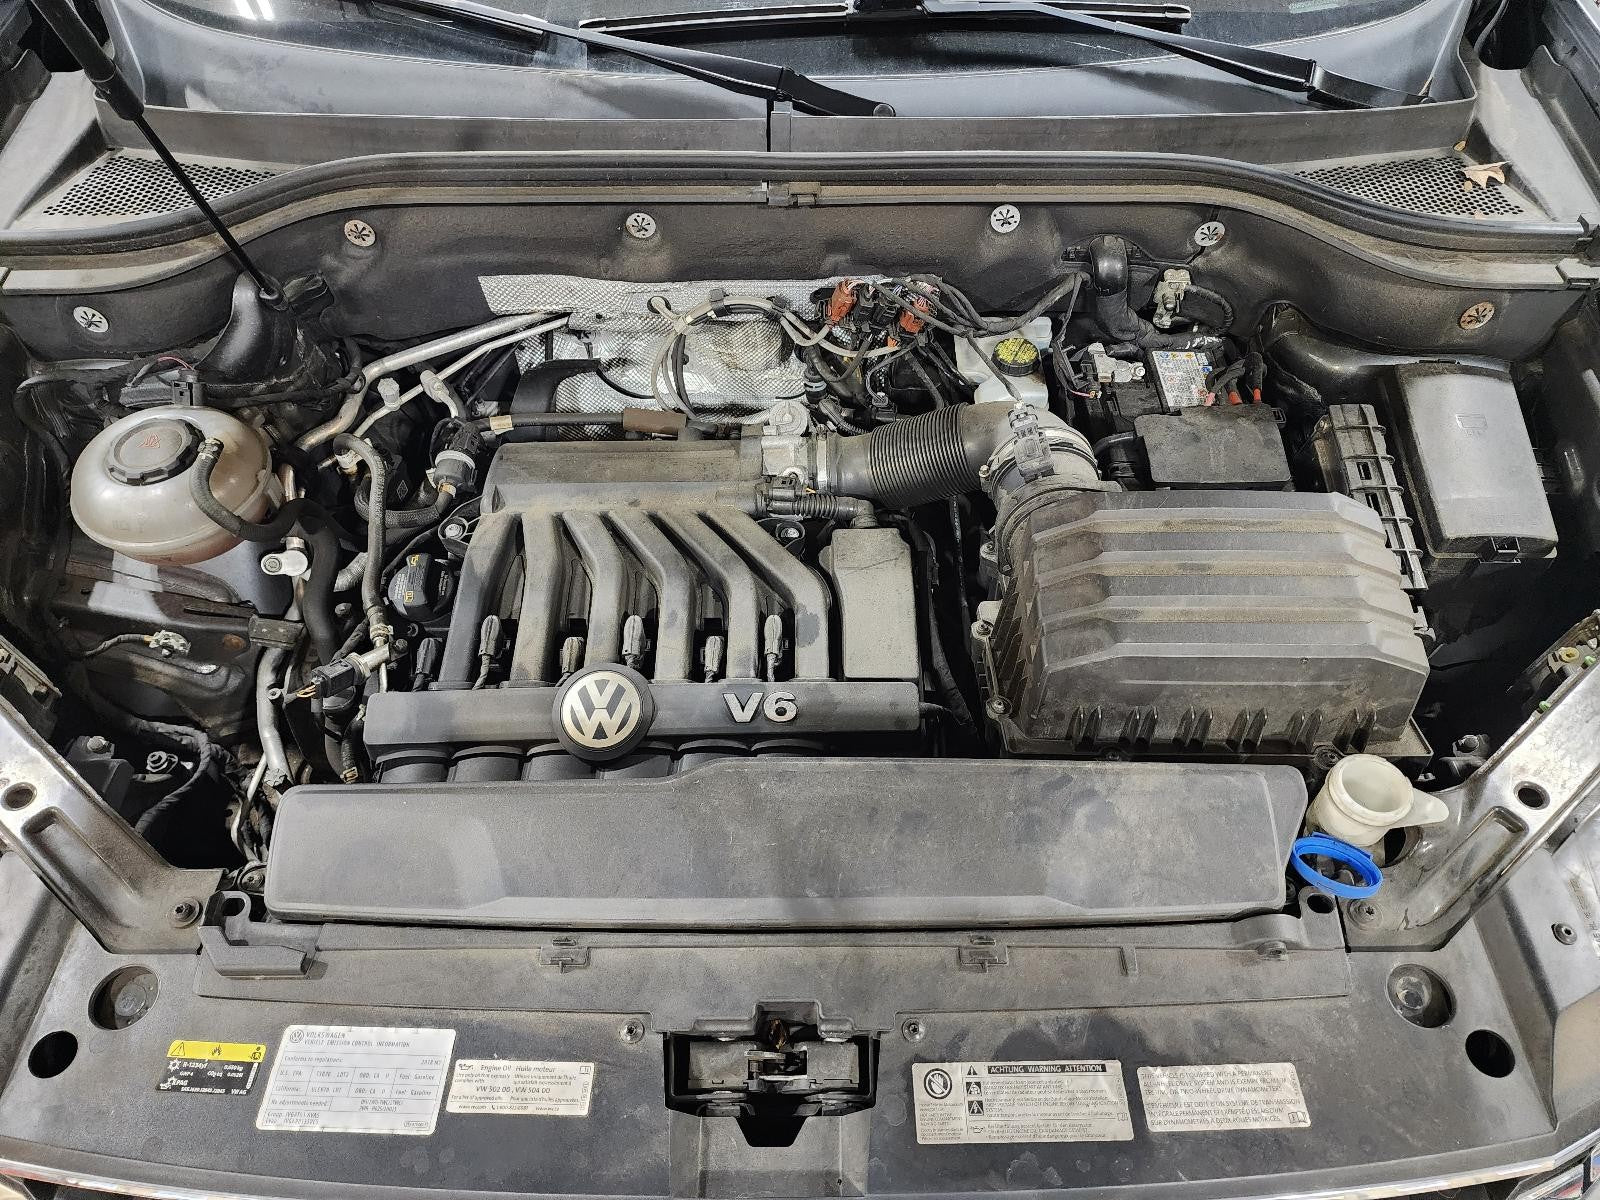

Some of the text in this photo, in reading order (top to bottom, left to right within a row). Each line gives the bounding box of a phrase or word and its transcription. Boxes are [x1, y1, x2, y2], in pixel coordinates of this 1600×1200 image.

[722, 691, 798, 723] V6
[480, 1064, 502, 1072] Engine
[990, 1064, 1103, 1073] ACHTUNG WARNING ATTENTION
